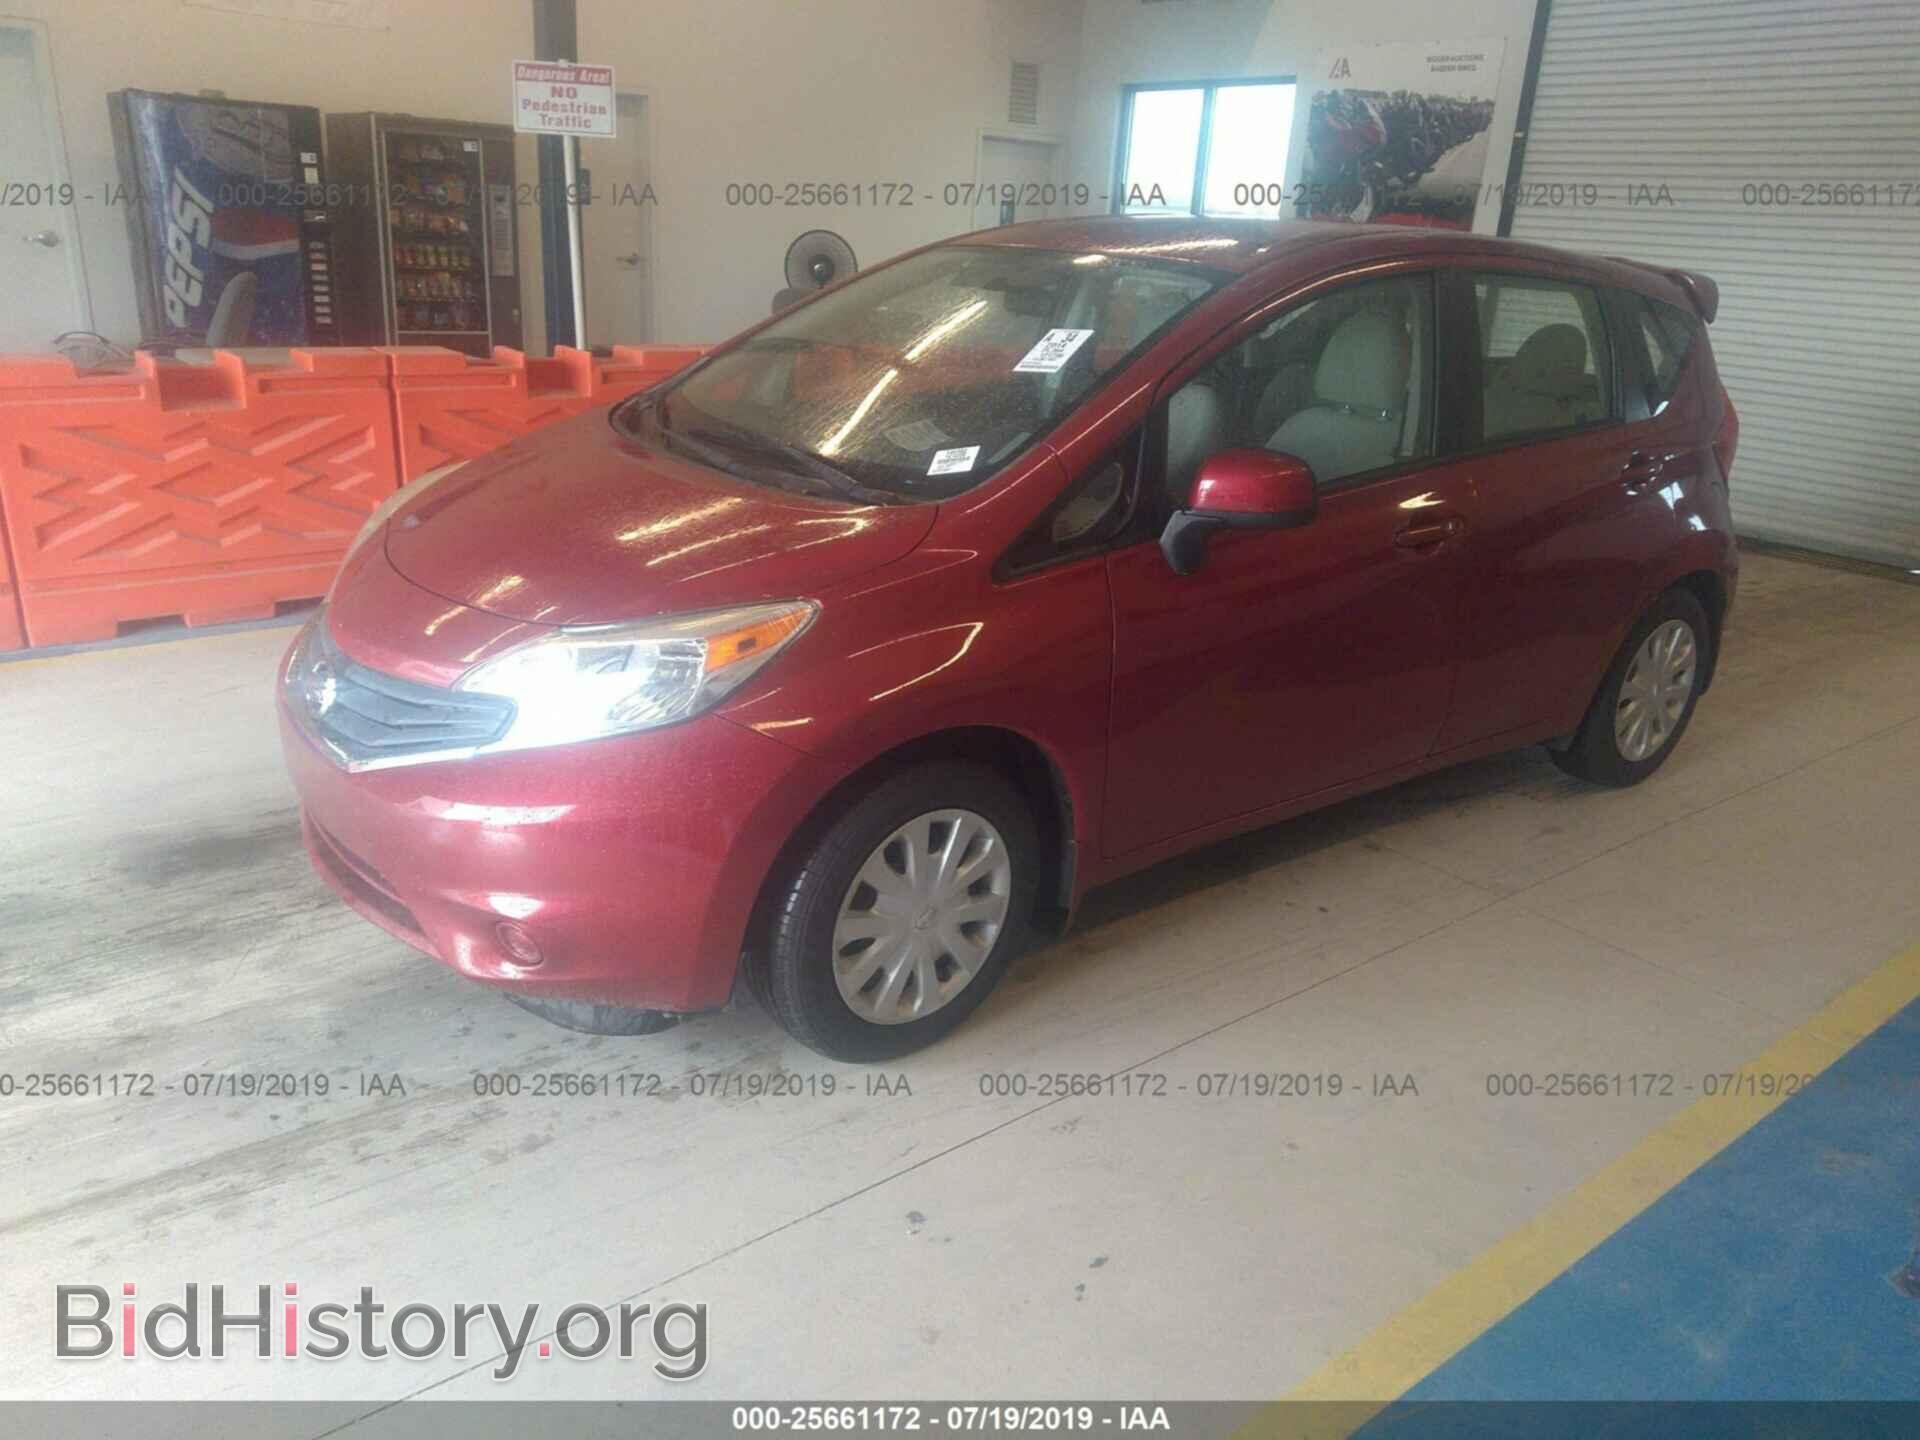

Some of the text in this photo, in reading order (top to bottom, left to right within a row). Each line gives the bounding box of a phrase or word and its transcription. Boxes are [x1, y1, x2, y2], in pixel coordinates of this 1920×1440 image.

[517, 66, 610, 85] Dangerous Area!
[550, 86, 578, 99] NO
[521, 98, 607, 115] Pedestrian
[538, 114, 592, 129] Traffic
[163, 166, 215, 328] PEPSI
